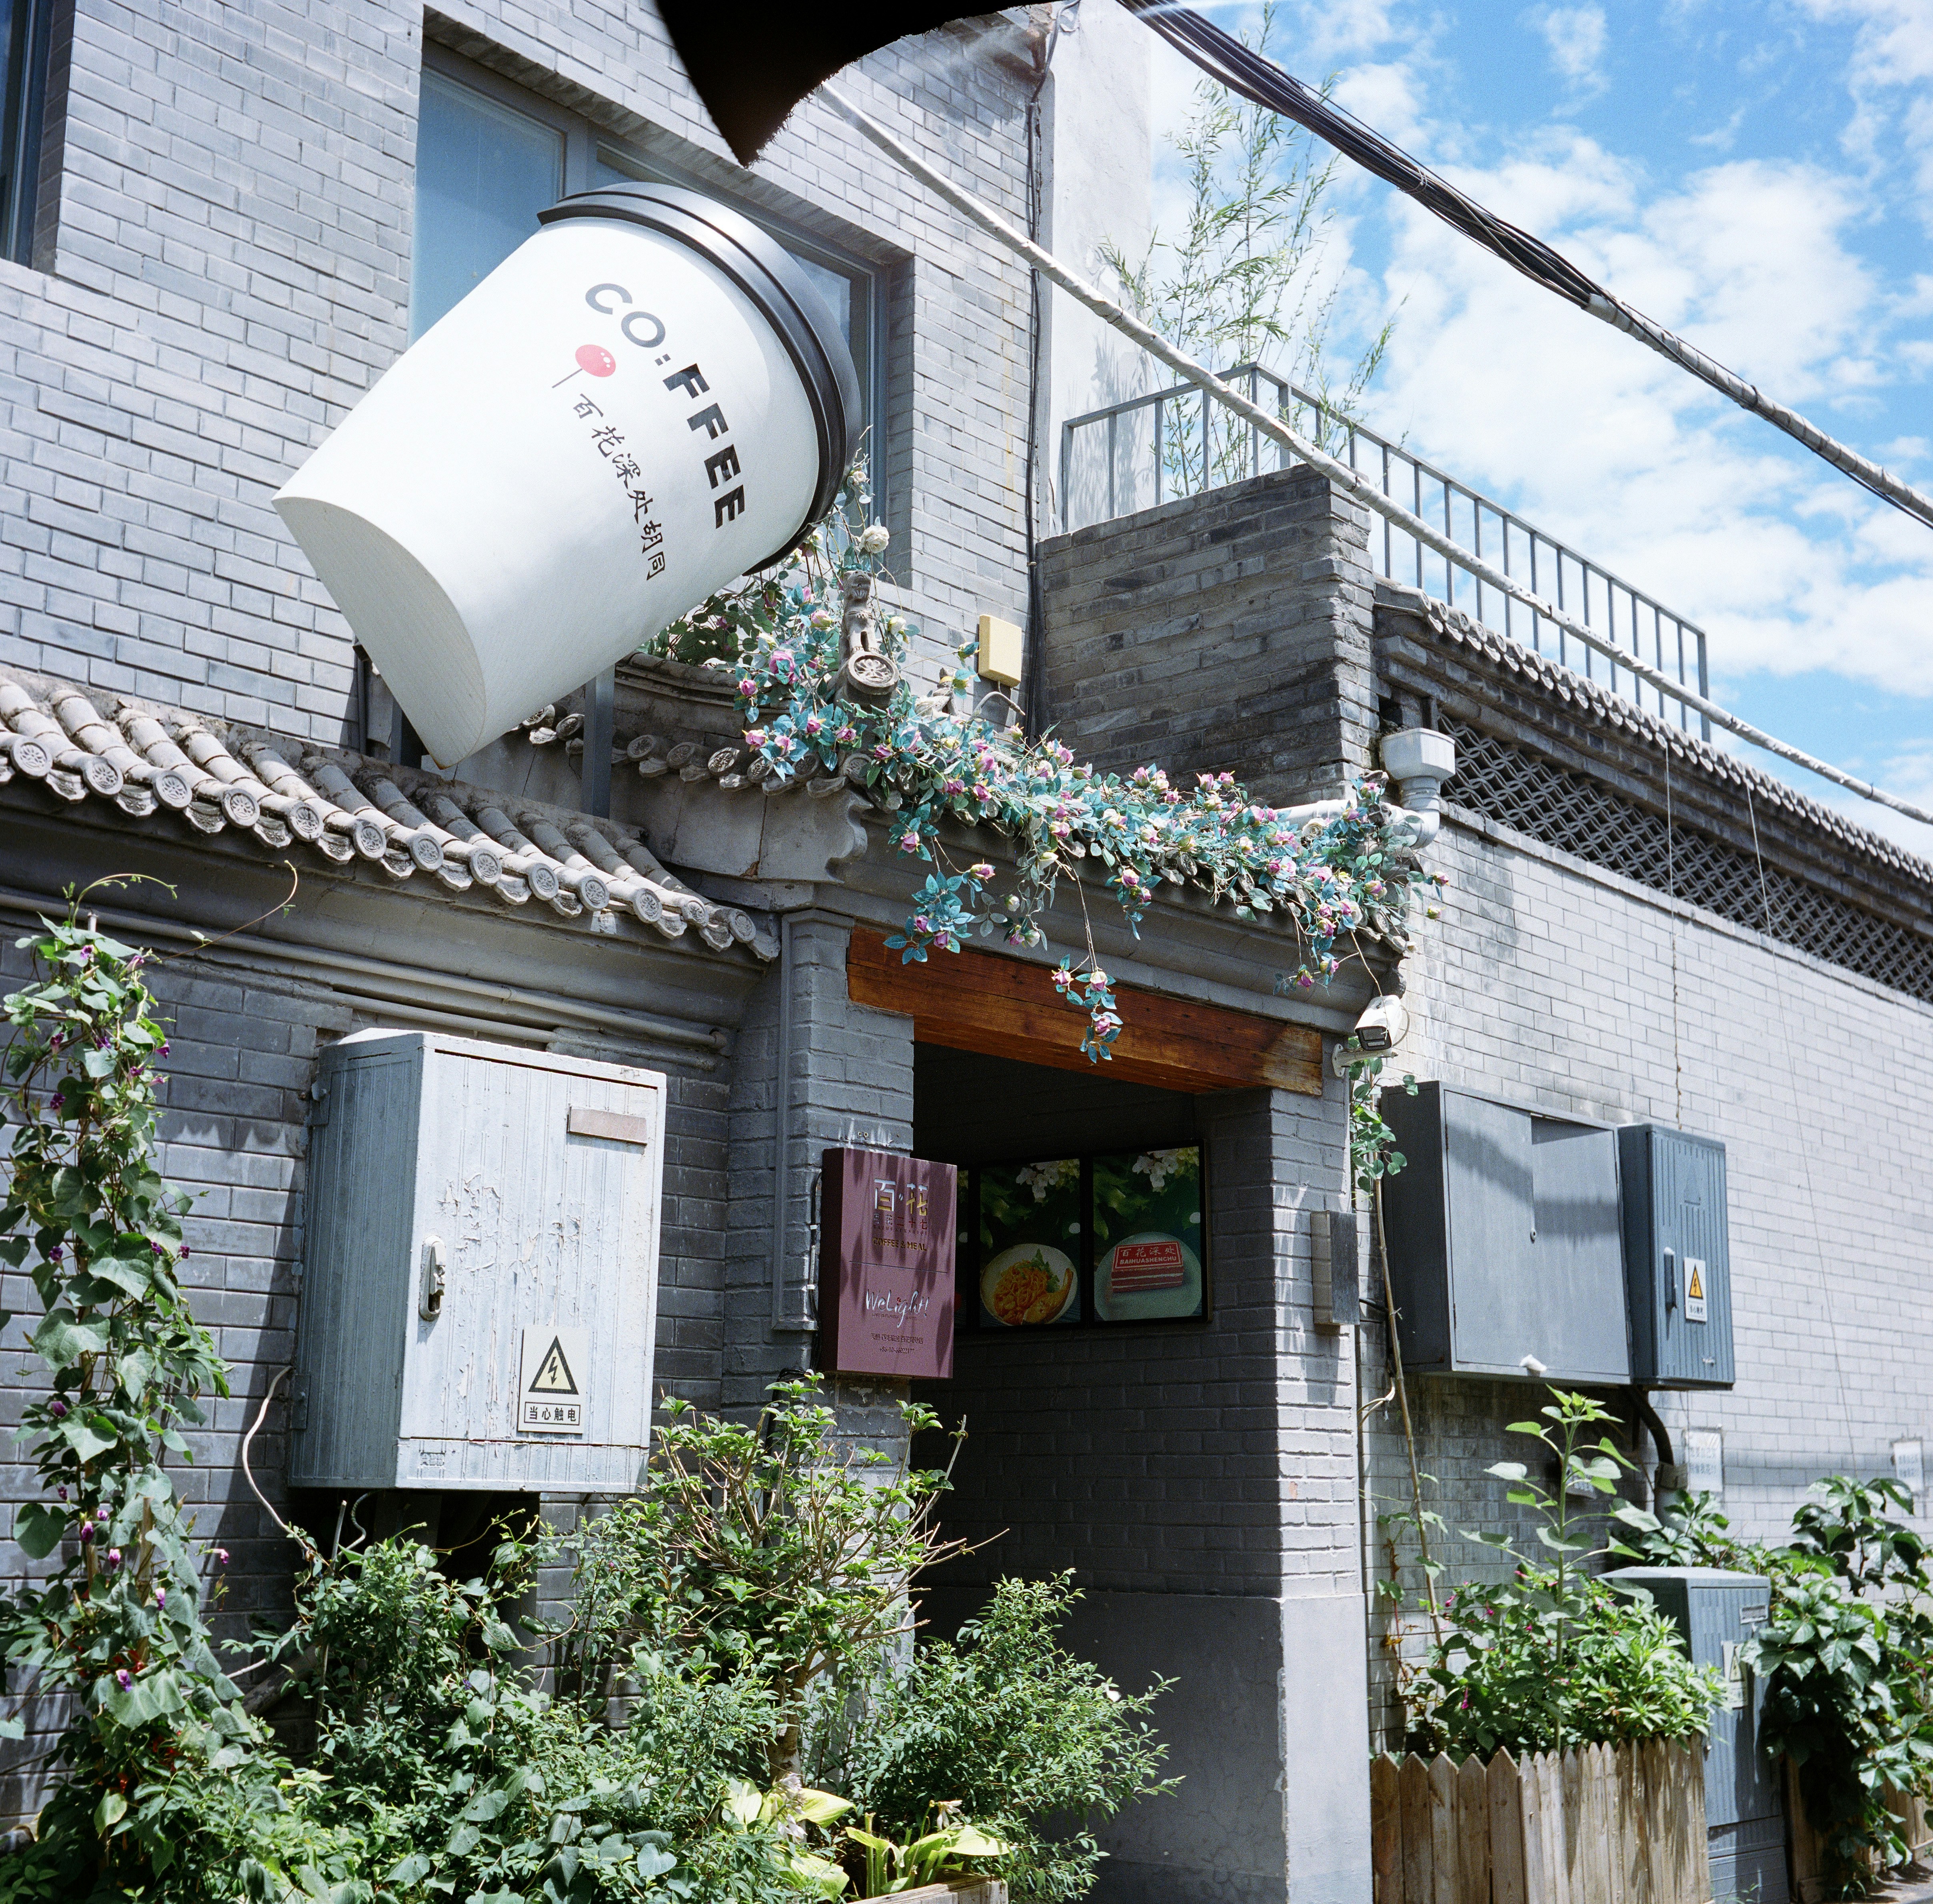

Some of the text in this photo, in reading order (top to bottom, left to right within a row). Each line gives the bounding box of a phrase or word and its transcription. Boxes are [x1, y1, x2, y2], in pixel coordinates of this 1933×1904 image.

[585, 283, 745, 529] CO:FFEE
[573, 393, 665, 580] 百花深处胡同
[873, 1213, 927, 1230] 百花二十七
[872, 1237, 898, 1248] COFFEE
[907, 1241, 927, 1251] MEAL
[1121, 1246, 1176, 1257] 百花深处
[1120, 1256, 1177, 1264] BAIHUASHENCHU
[529, 1406, 576, 1422] 当心触电
